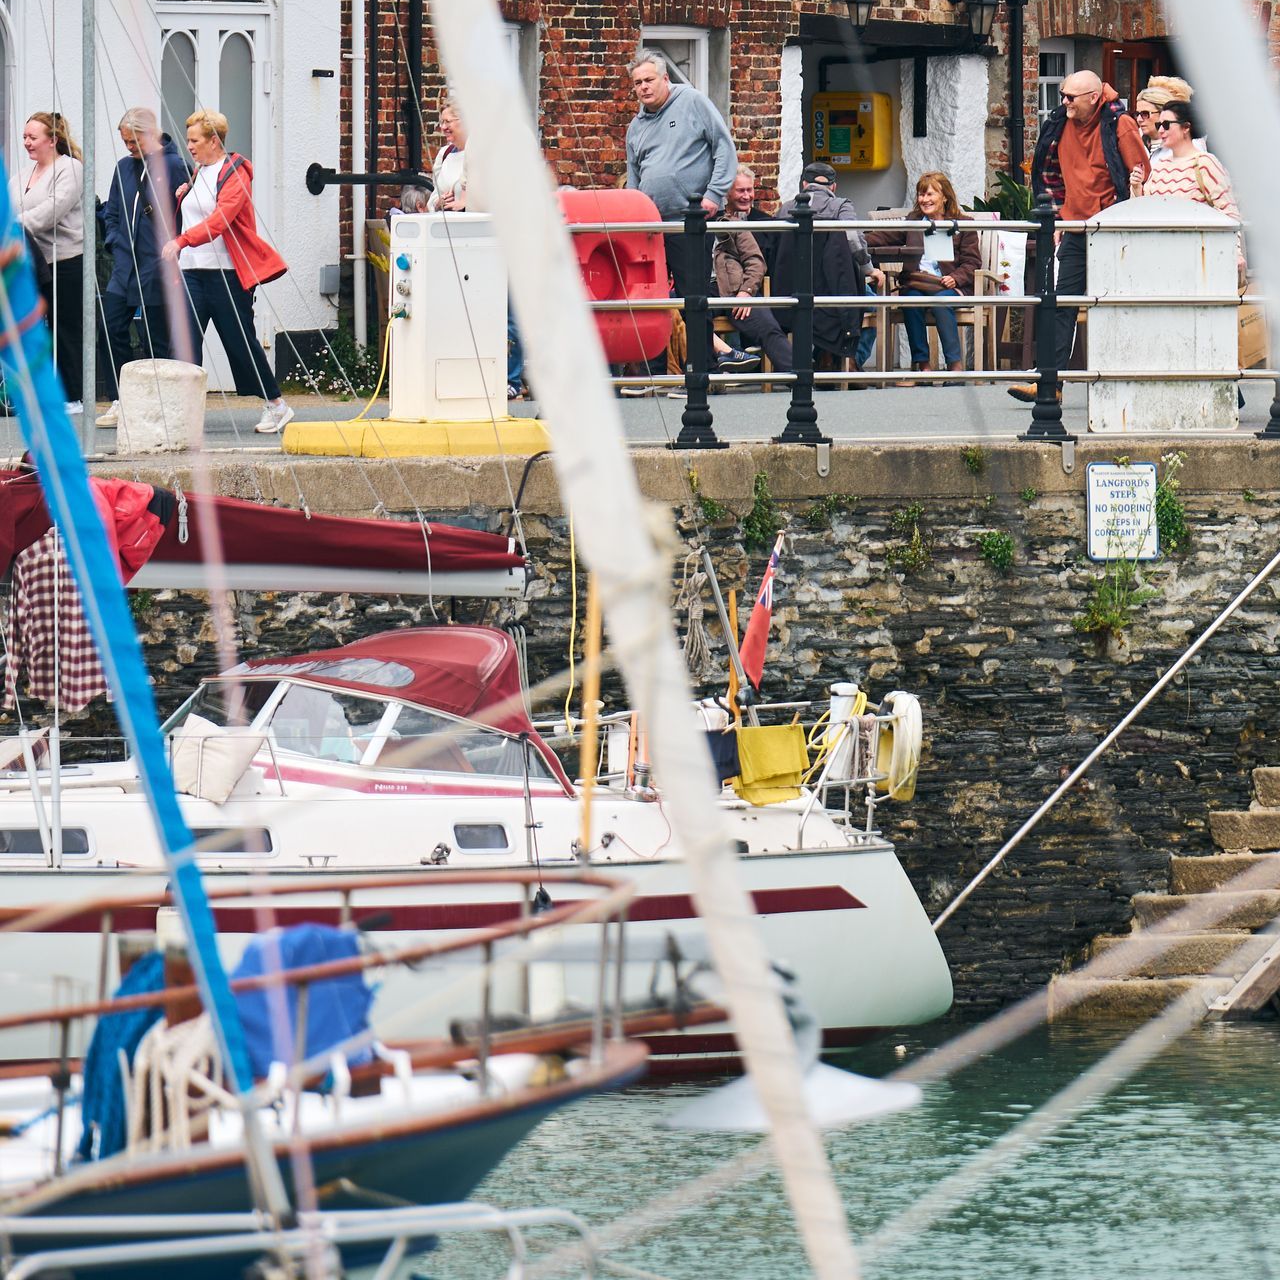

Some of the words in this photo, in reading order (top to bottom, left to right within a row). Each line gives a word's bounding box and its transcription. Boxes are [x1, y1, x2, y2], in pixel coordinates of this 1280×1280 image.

[1110, 490, 1137, 499] STEPS
[1095, 504, 1108, 513] NO
[1110, 504, 1151, 513] MOORING
[1106, 518, 1131, 526] STEPS
[1095, 529, 1135, 537] CONSTANT
